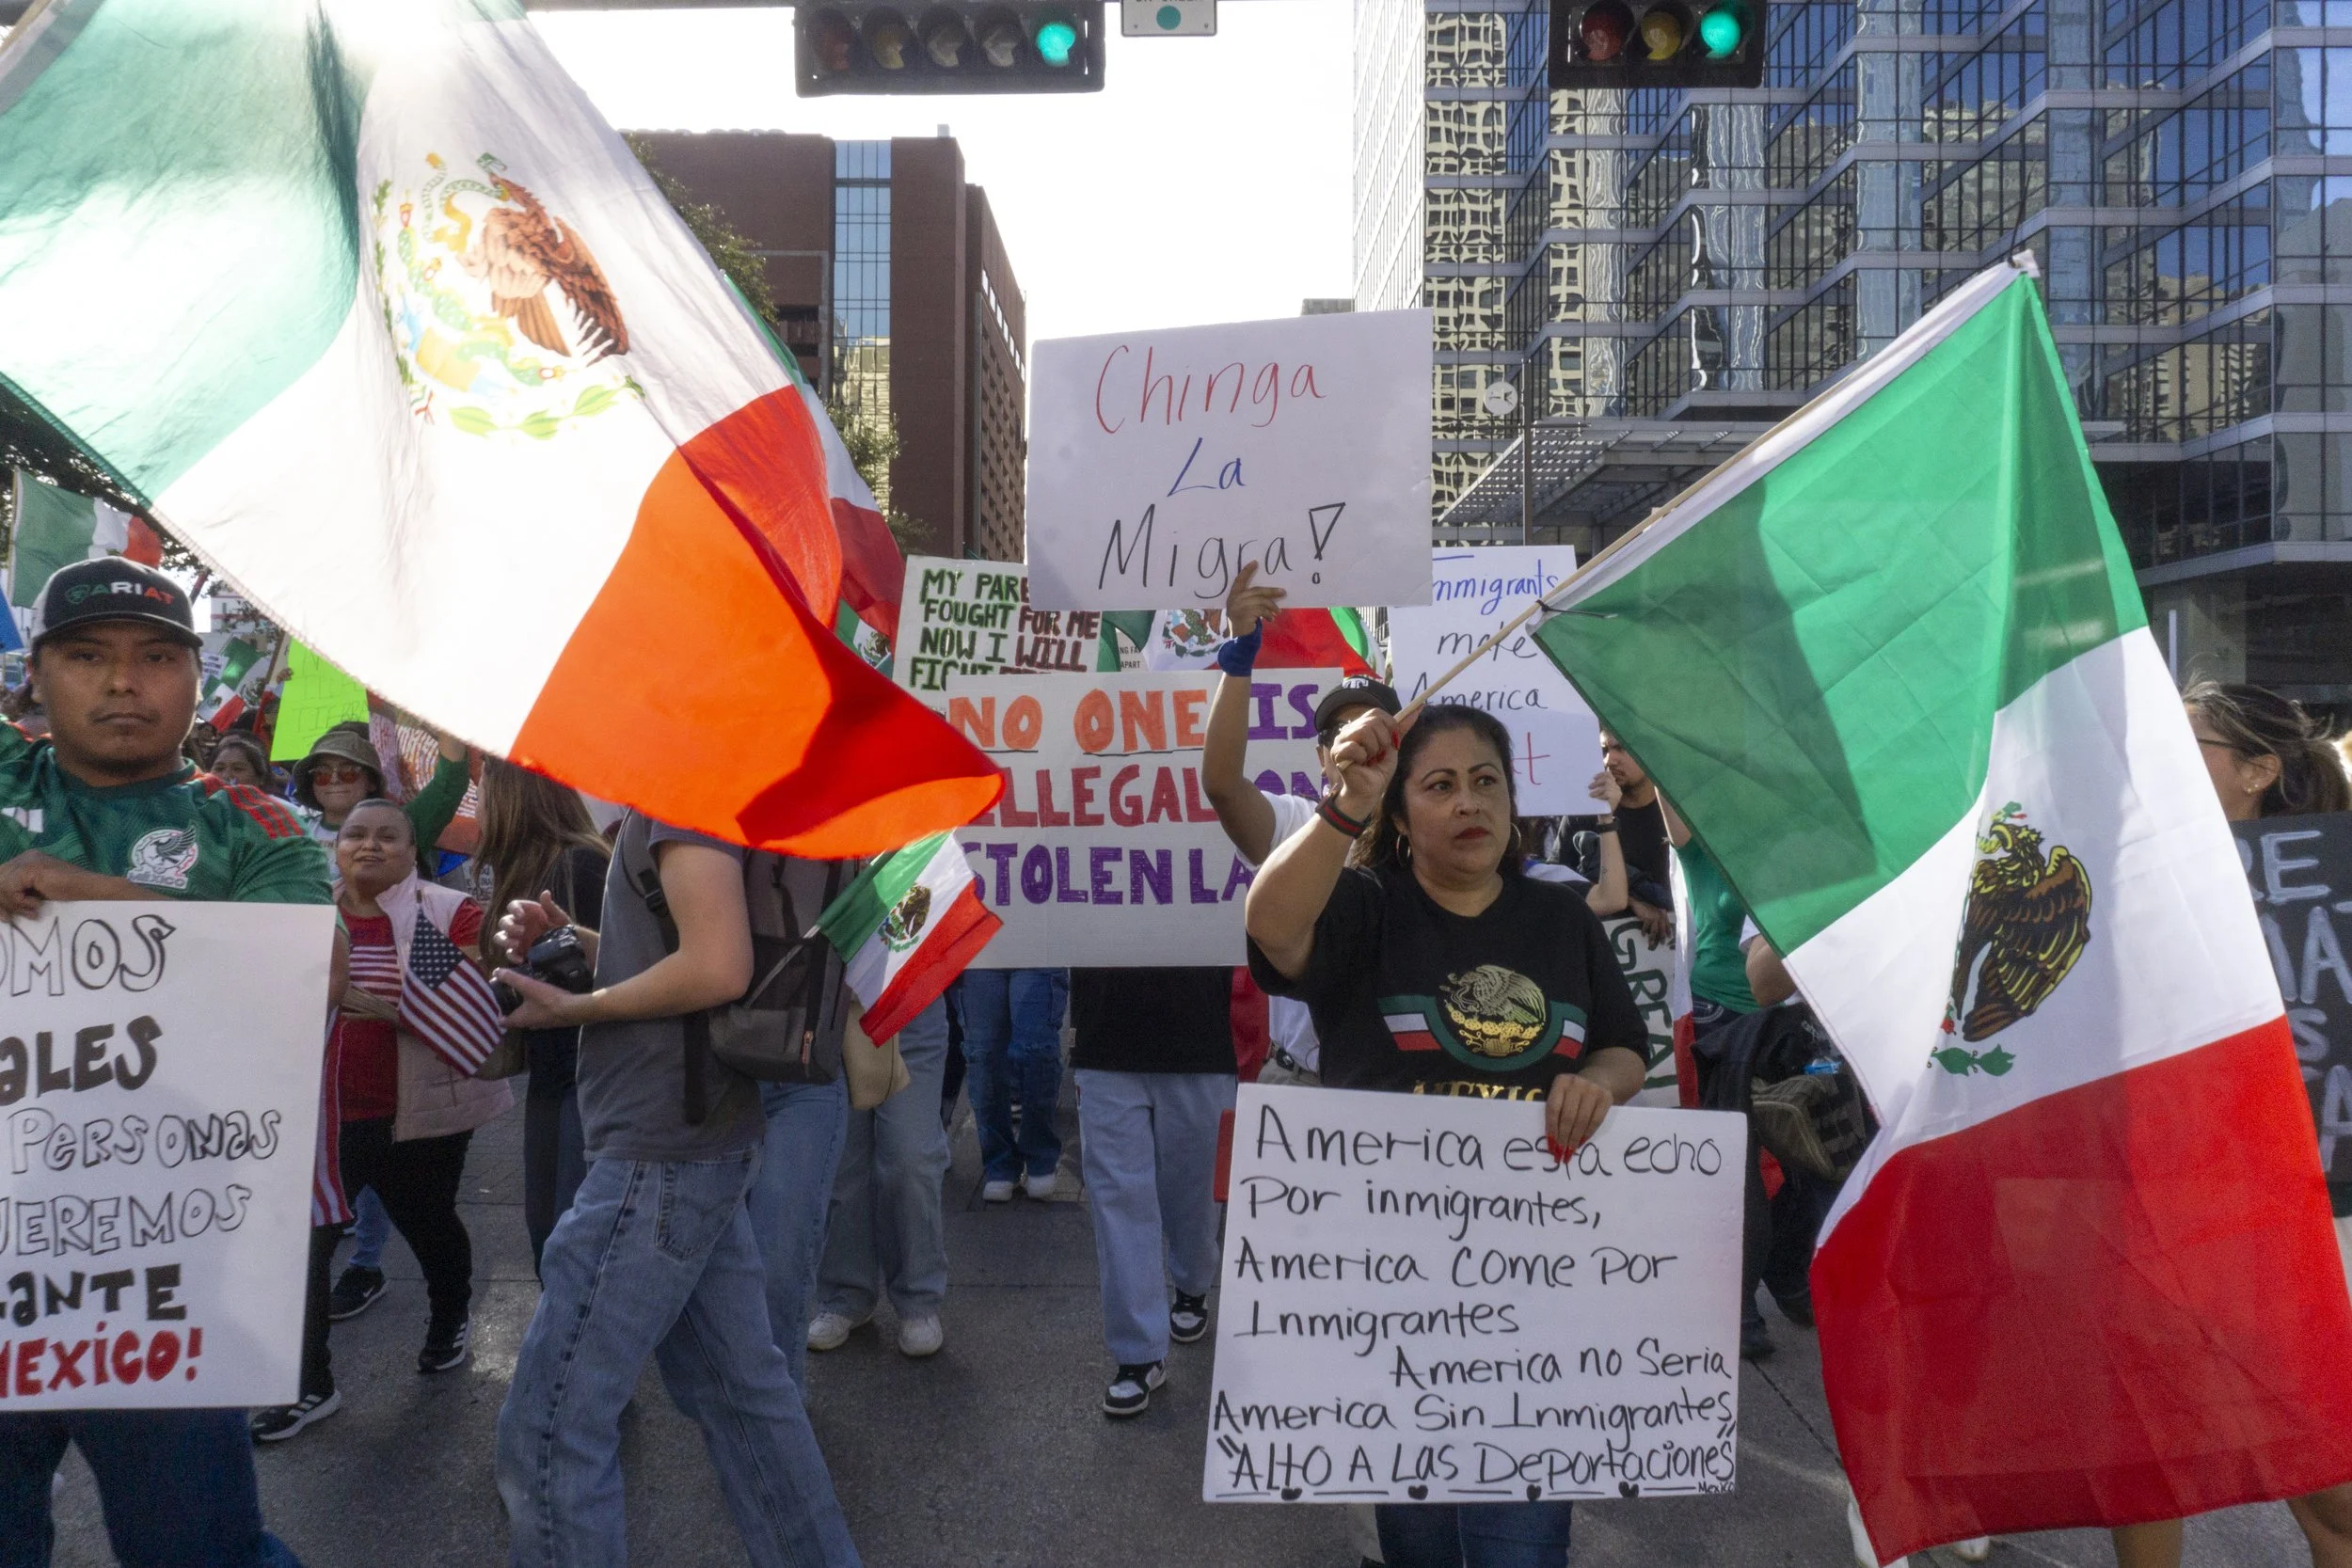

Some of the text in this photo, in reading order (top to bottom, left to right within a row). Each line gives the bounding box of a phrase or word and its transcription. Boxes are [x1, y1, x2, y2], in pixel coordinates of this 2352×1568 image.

[1096, 345, 1327, 435] Chinga
[1166, 436, 1248, 498] La
[1098, 500, 1346, 599] Migra!
[90, 581, 174, 604] ARIAT
[920, 568, 963, 605] MY
[923, 598, 1101, 640] FOUGHT FOR ME
[919, 626, 1087, 673] NOW I WILL
[949, 683, 1319, 753] NO ONE IS
[968, 764, 1220, 829] LLEGAL
[0, 913, 177, 997] MOS
[1256, 1104, 1484, 1171] America
[1624, 1132, 1722, 1176] echo
[0, 1183, 252, 1257] EREMOS
[1240, 1176, 1601, 1242] Por inmigrantes,
[1234, 1236, 1427, 1282] America
[1233, 1300, 1520, 1356] Inmigrantes
[1389, 1337, 1732, 1390] America no Seria
[1213, 1389, 1397, 1434] America
[1415, 1393, 1485, 1432] Sin
[1348, 1444, 1375, 1484] A
